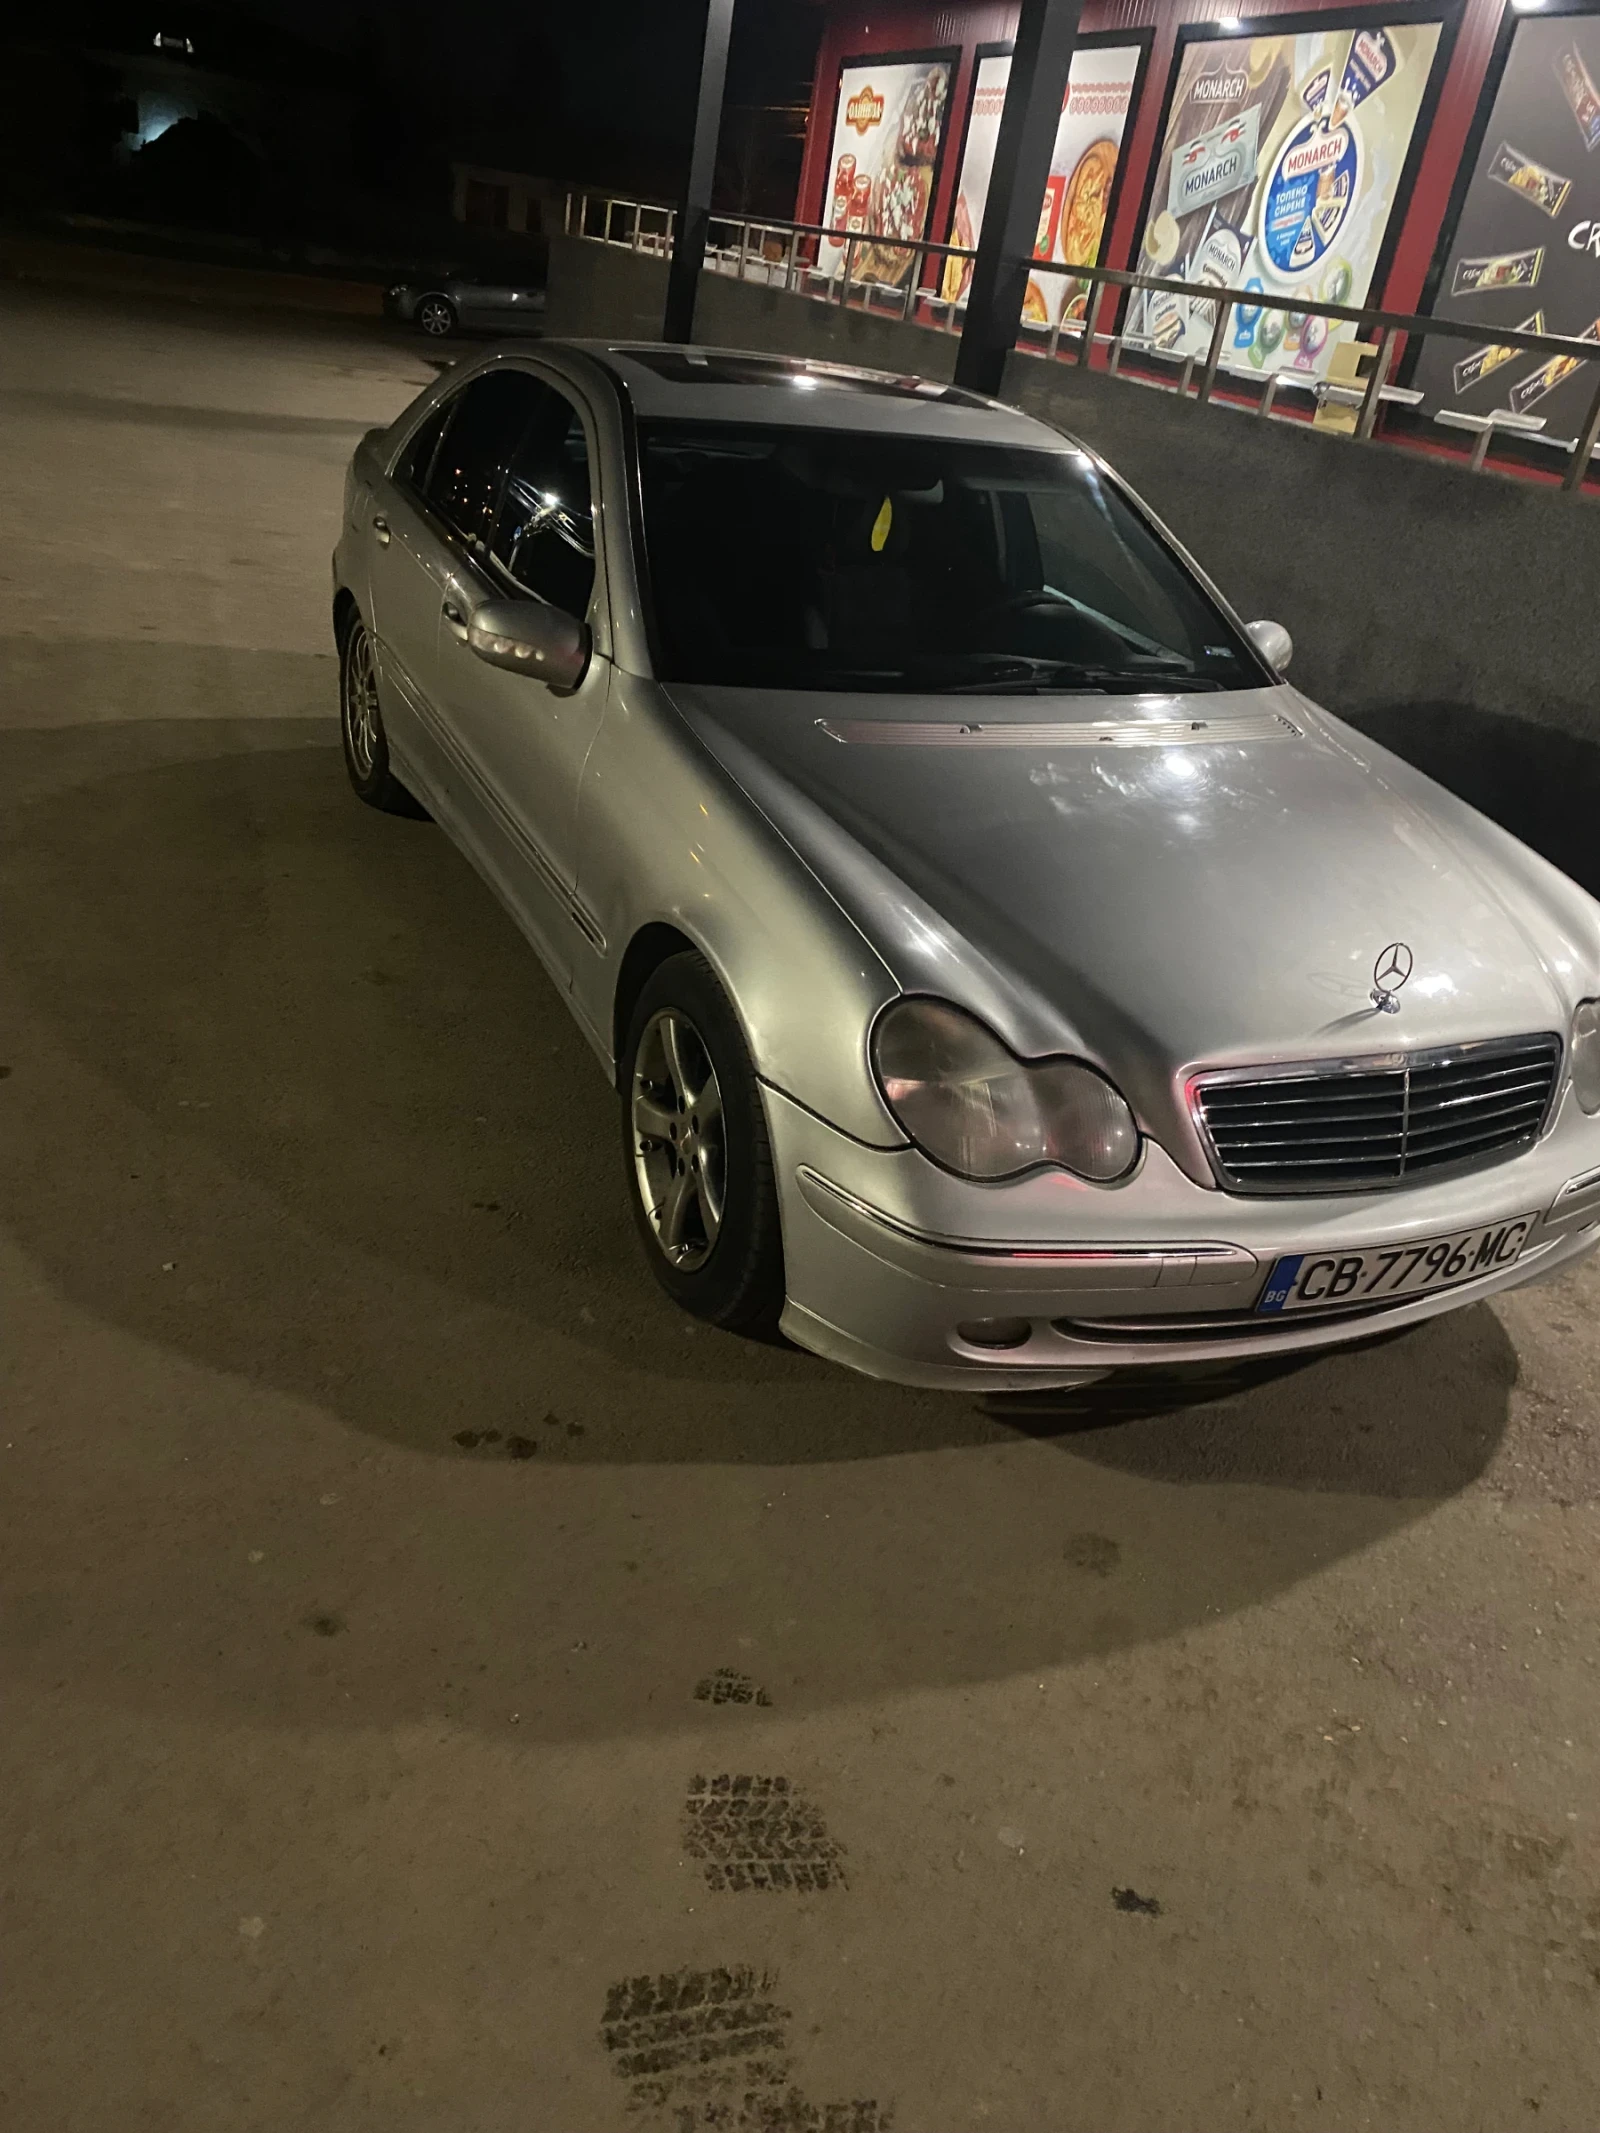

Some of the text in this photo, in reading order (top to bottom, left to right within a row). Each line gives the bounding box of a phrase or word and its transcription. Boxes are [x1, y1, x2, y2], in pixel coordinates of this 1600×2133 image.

[1193, 77, 1245, 99] MONARCH
[1288, 137, 1343, 172] MONARCH
[1184, 155, 1238, 197] MONARCH
[1273, 197, 1306, 218] СИРЕНЕ
[1208, 243, 1236, 272] MONARCH
[1297, 1221, 1527, 1300] CB 7796 MC
[1264, 1290, 1287, 1303] BG
